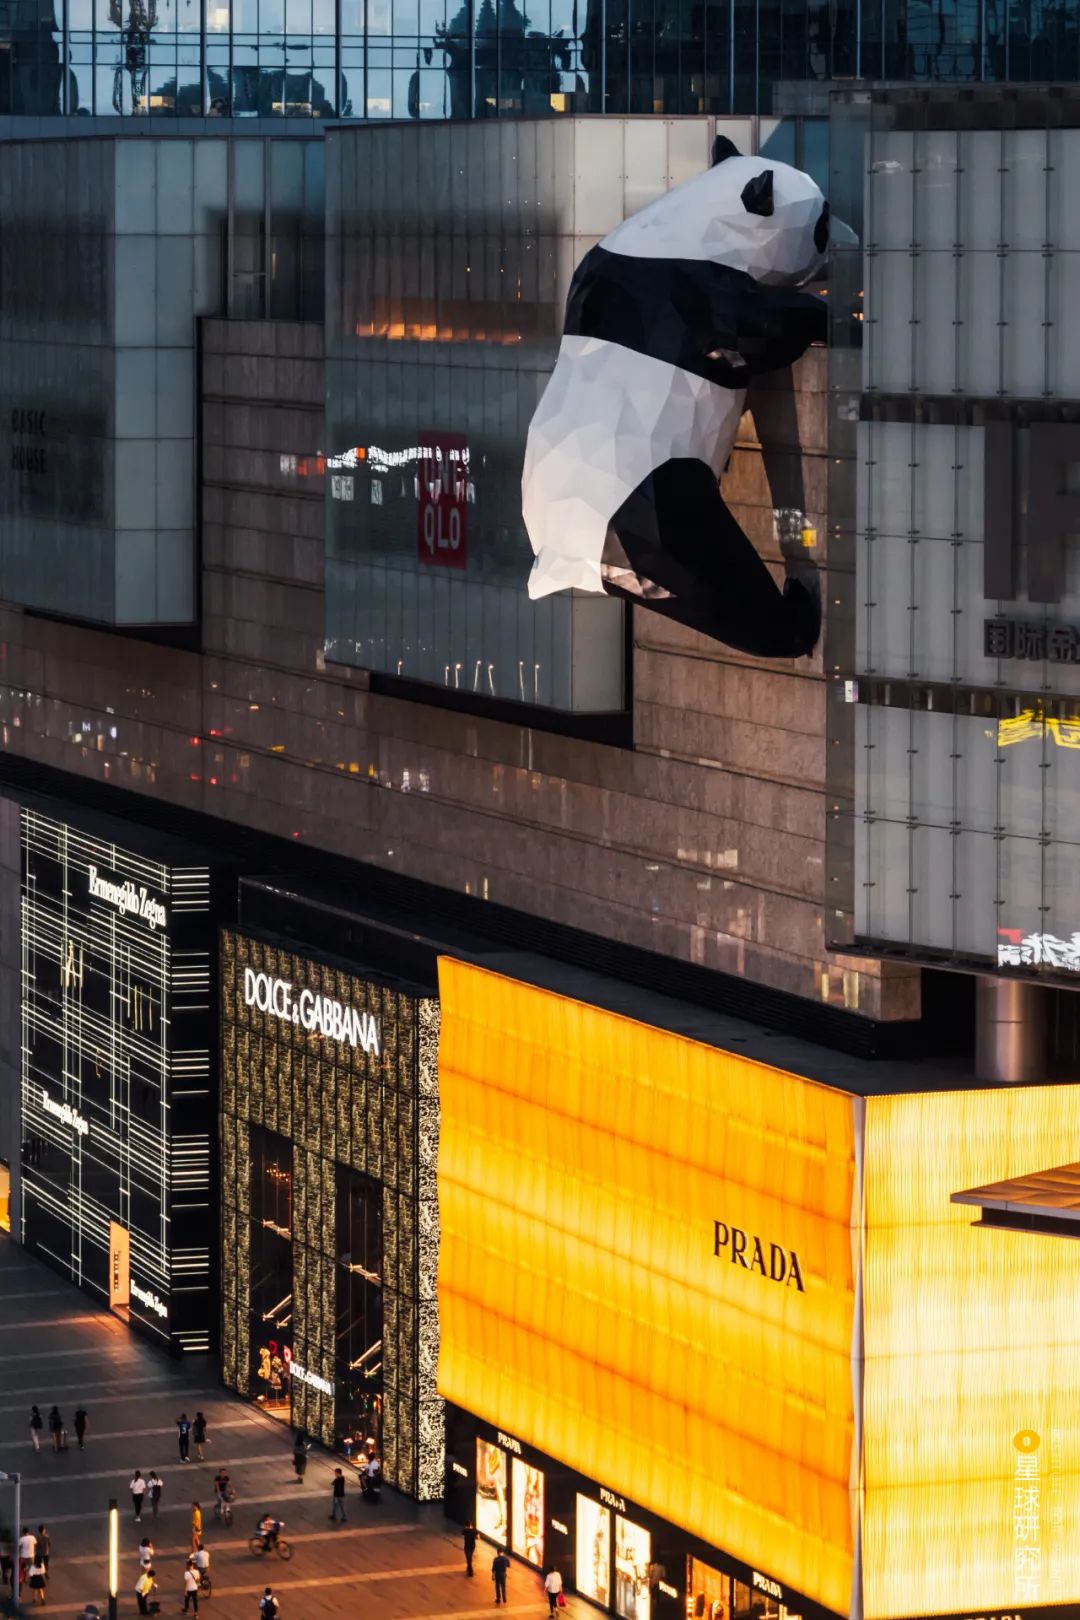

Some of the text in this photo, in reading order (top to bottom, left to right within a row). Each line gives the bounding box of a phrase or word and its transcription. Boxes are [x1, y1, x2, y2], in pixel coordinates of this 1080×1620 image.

[423, 503, 461, 555] QLO
[88, 864, 166, 930] Ermenegildo Zegna
[713, 1219, 805, 1293] PRADA
